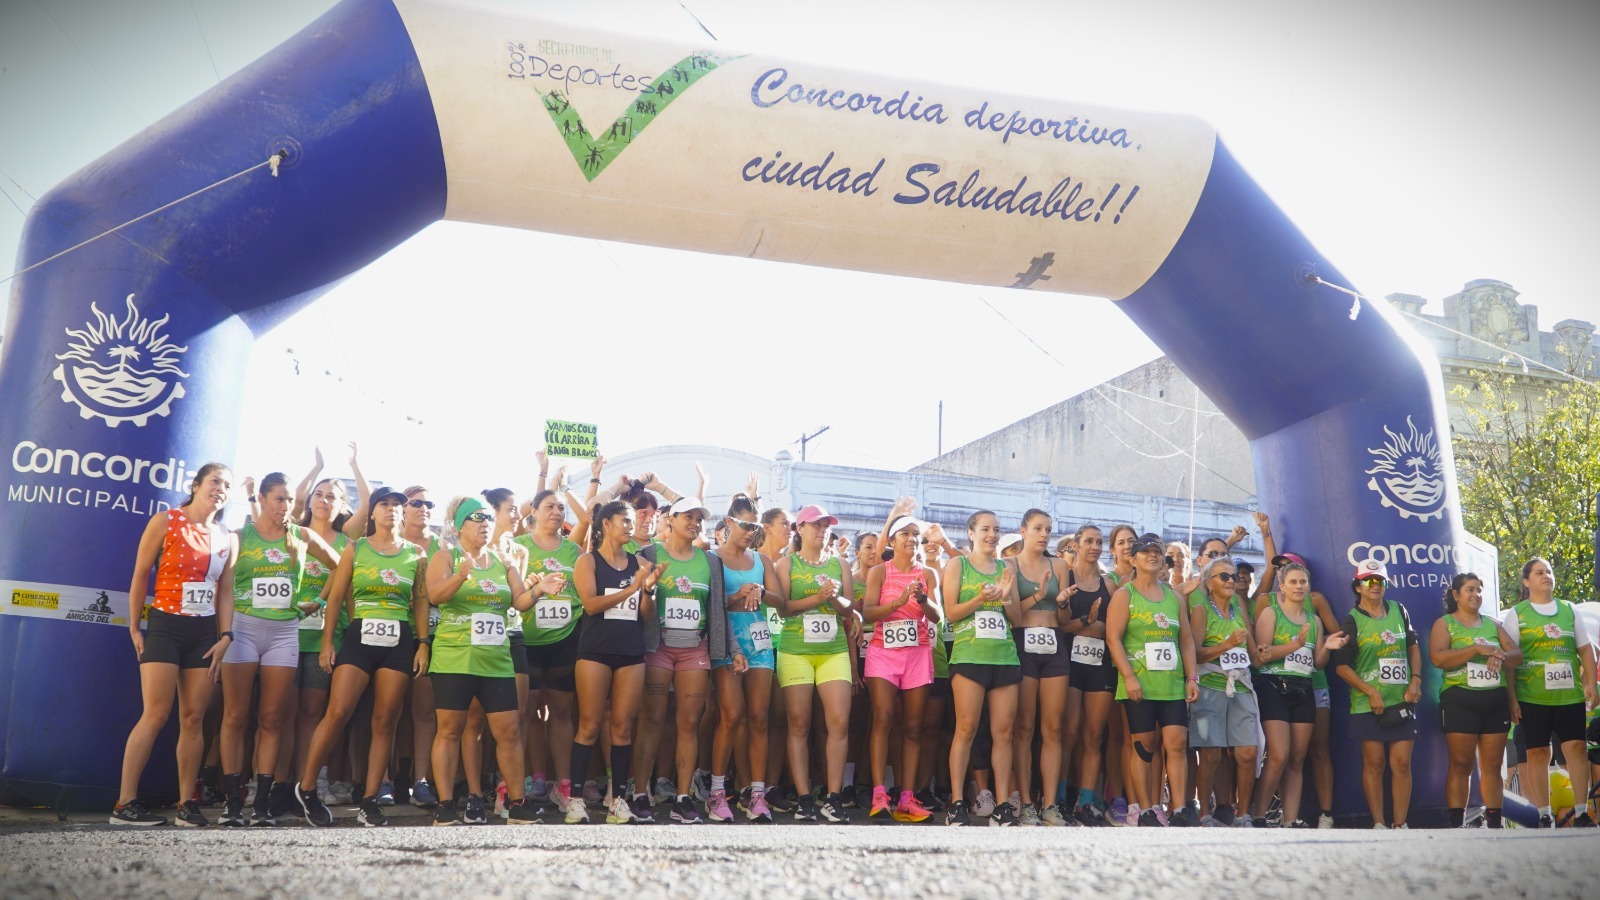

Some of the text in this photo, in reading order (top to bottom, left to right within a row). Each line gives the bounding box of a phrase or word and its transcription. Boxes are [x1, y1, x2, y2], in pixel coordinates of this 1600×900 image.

[507, 41, 526, 79] 100%
[528, 55, 656, 95] Deportes
[750, 68, 949, 125] Concordia
[741, 151, 1140, 225] ciudad Saludable!!
[546, 421, 597, 435] VAMOS COLO
[12, 440, 198, 495] Concordia
[7, 484, 171, 517] MUNICIPALID
[186, 589, 214, 604] 179
[255, 582, 291, 598] 508
[65, 612, 94, 622] AMIGOS
[95, 615, 110, 623] DEL
[538, 606, 569, 620] 119
[666, 607, 700, 621] 1340
[364, 621, 398, 638] 281
[474, 620, 505, 636] 375
[811, 620, 831, 633] 30
[977, 617, 1006, 631] 384
[884, 627, 917, 644] 869
[1027, 633, 1055, 646] 383
[1073, 644, 1104, 659] 1346
[1154, 648, 1172, 661] 76
[1222, 652, 1248, 664] 398
[1286, 652, 1313, 667] 3032
[1380, 665, 1407, 680] 868
[1469, 669, 1500, 681] 1404
[1546, 669, 1573, 682] 3044
